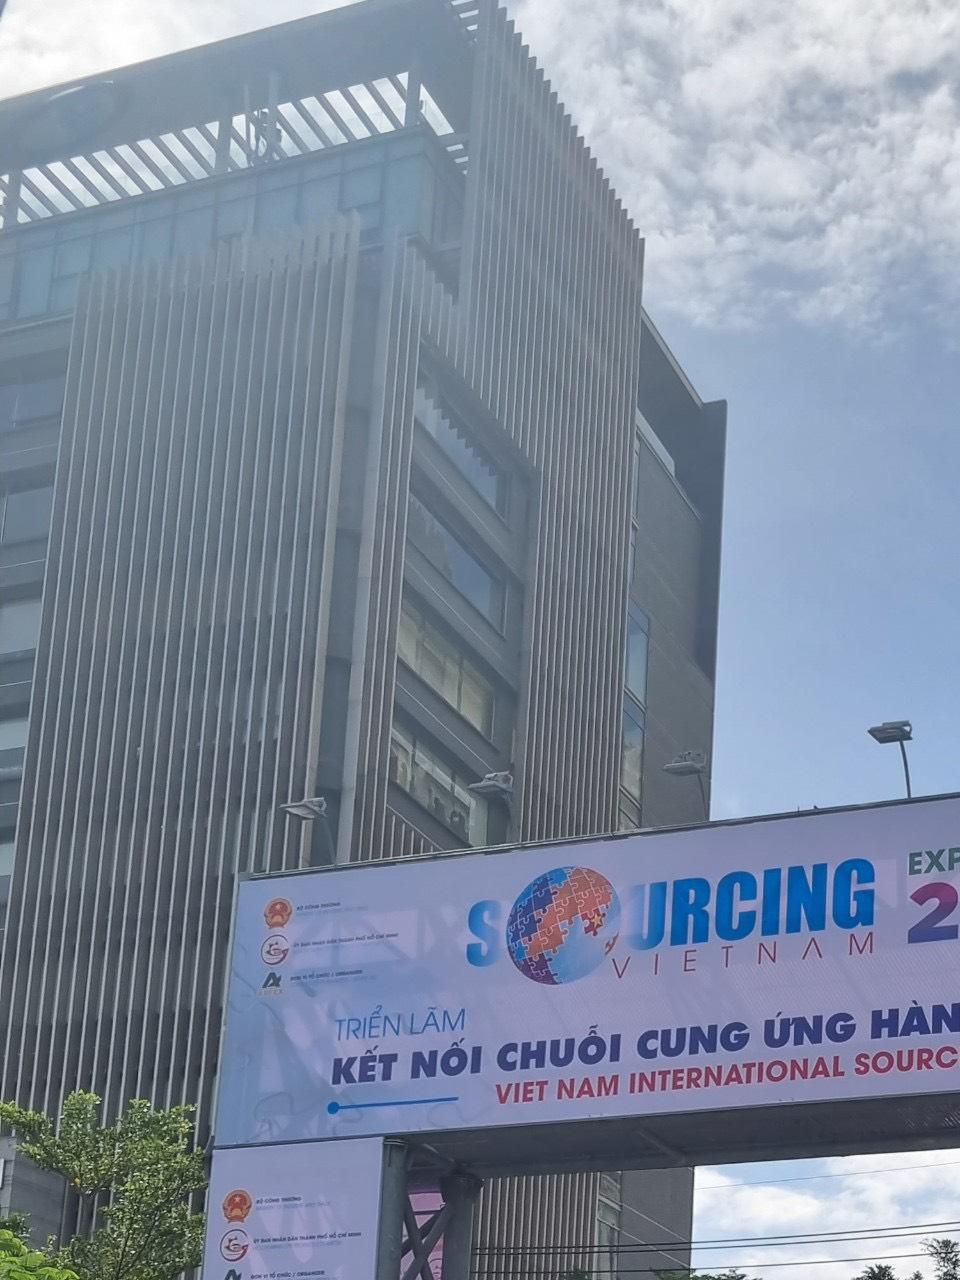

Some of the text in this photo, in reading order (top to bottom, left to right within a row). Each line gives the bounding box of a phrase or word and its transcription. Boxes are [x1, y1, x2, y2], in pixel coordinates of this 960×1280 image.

[612, 932, 873, 979] VIETNAM
[335, 1004, 466, 1041] TRIỂN LÃM
[331, 1045, 398, 1085] KẾT
[410, 1038, 483, 1080] NỐI
[496, 1024, 621, 1072] CHUỖI
[637, 1021, 750, 1060] CUNG
[764, 1011, 856, 1048] ỨNG
[496, 1080, 549, 1104] VIET
[557, 1074, 619, 1100] NAM
[629, 1056, 845, 1094] INTERNATIONAL
